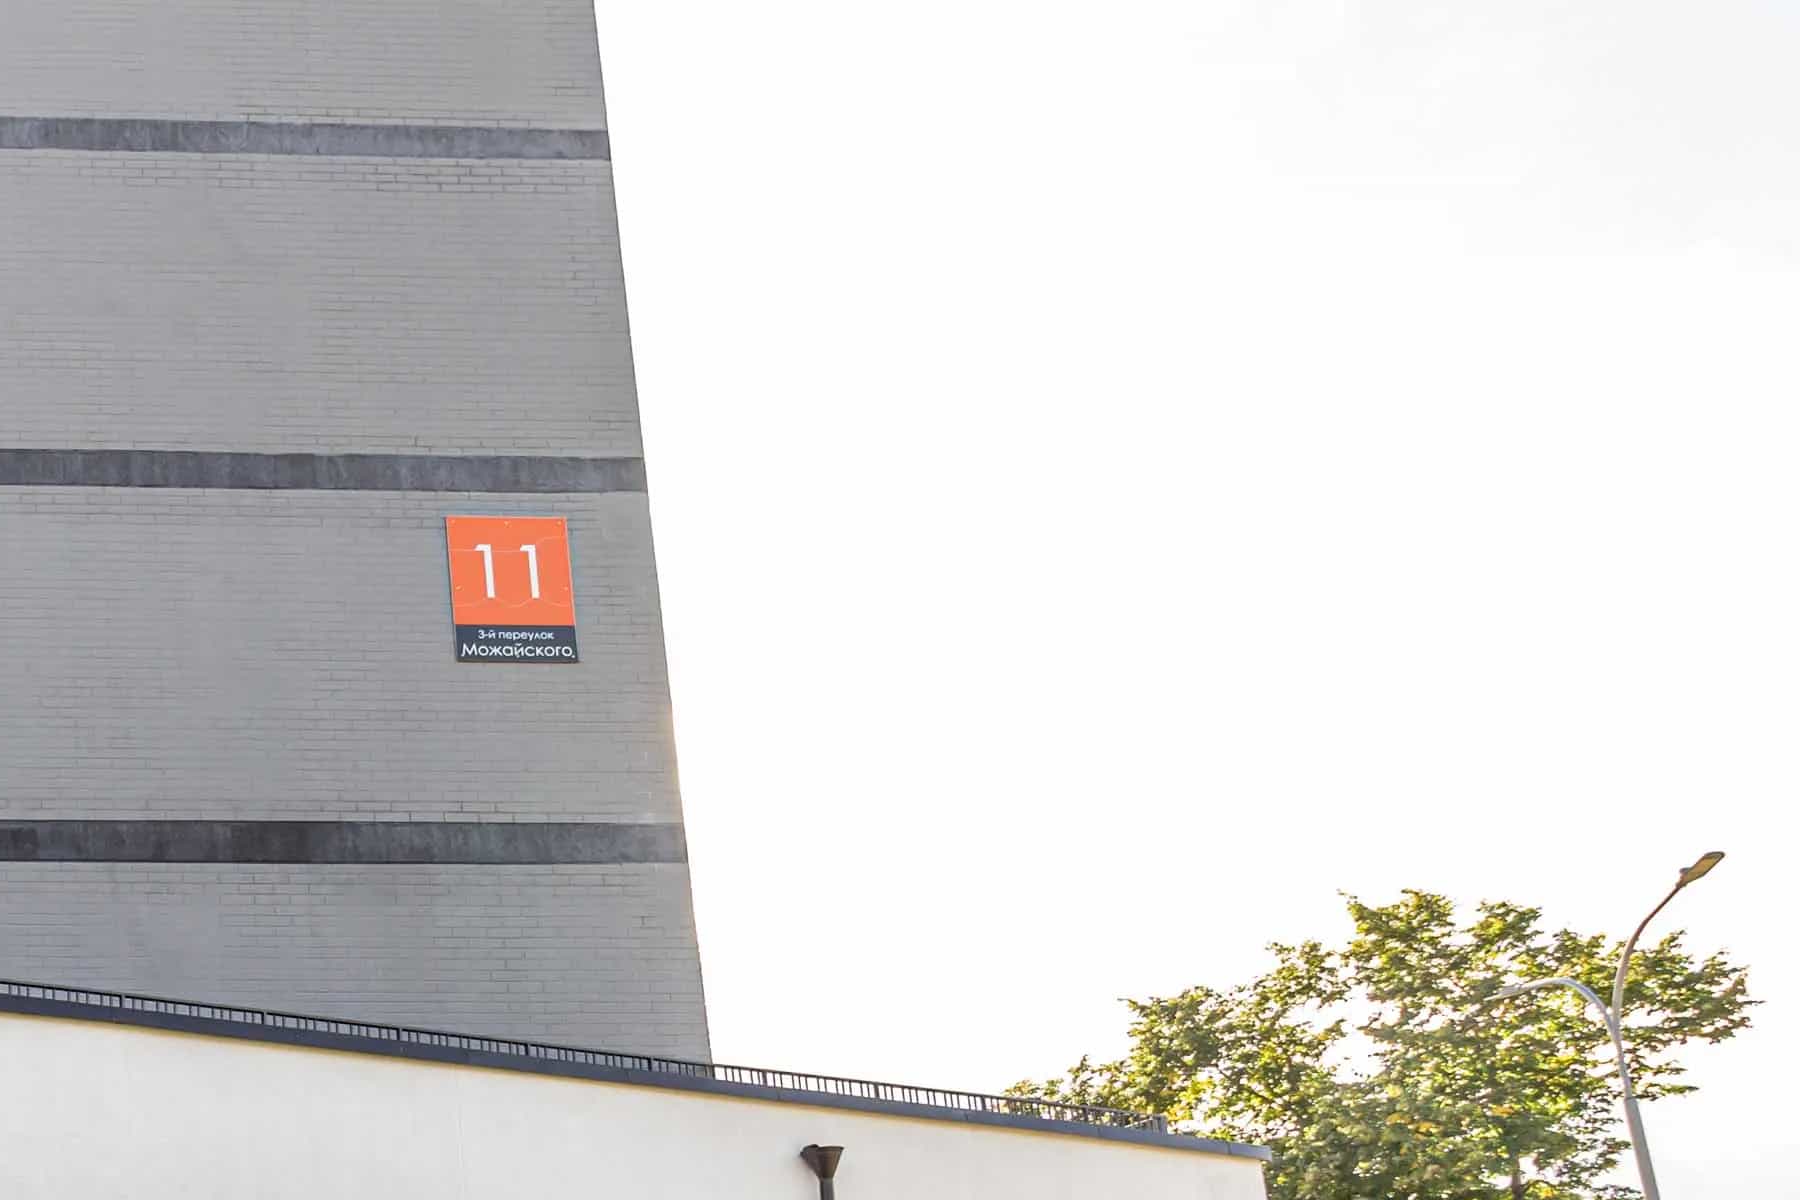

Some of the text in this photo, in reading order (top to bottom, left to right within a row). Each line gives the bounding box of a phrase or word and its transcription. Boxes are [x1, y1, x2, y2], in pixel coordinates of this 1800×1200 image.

[474, 543, 540, 598] 11
[478, 629, 555, 641] 3-й переулок
[460, 642, 573, 657] Можайского
